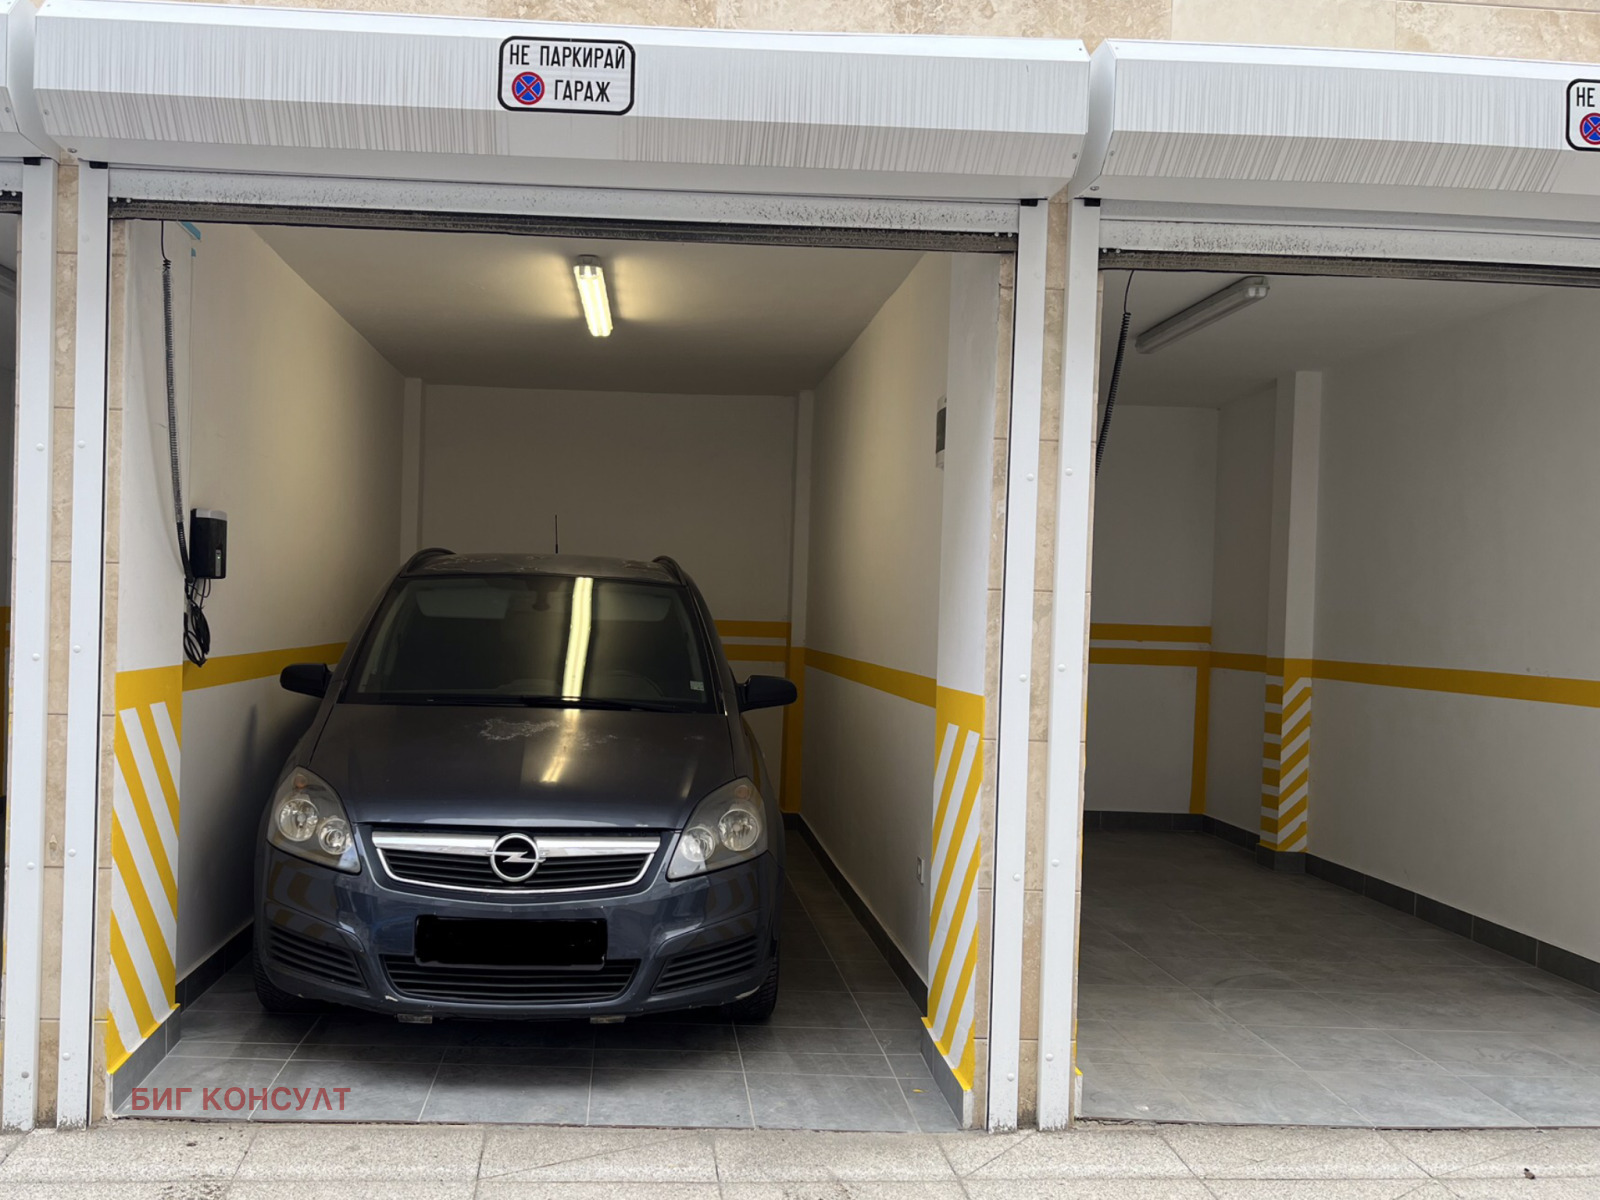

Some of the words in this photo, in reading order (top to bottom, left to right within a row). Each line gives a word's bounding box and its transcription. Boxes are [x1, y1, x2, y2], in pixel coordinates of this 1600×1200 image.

[509, 44, 530, 65] НЕ
[540, 45, 625, 69] ПАРКИРАЙ
[554, 79, 611, 102] ГАРАЖ
[1576, 87, 1595, 107] НЕ
